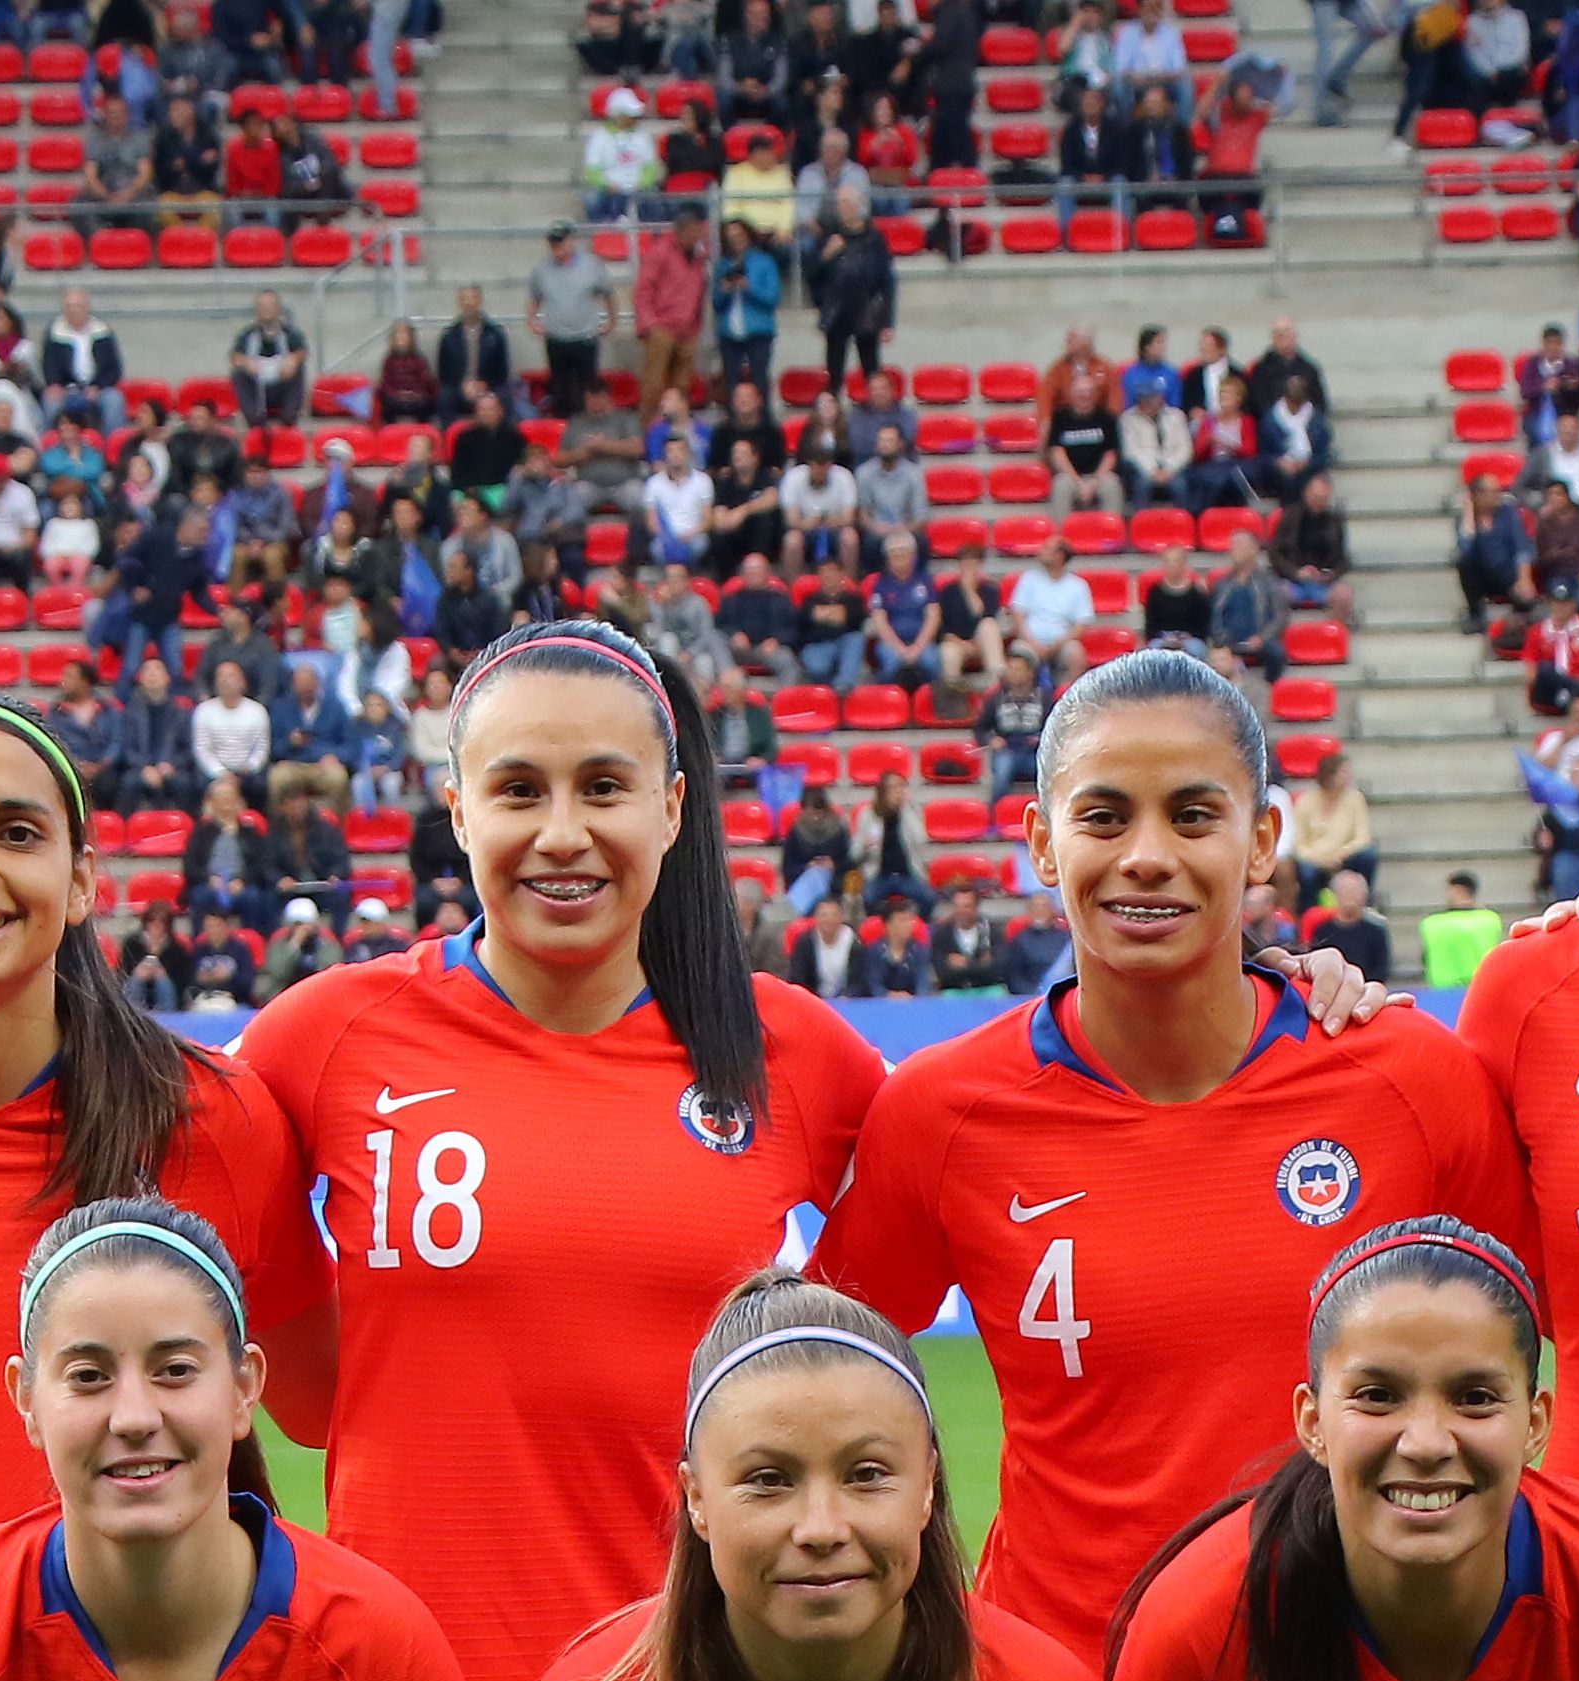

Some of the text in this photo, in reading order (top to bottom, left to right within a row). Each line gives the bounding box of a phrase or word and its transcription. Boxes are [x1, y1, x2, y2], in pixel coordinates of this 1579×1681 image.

[367, 1129, 486, 1268] 18
[1276, 1140, 1359, 1188] FEDERACION DE FUTBOL
[1420, 1233, 1454, 1244] NIKE
[1019, 1239, 1090, 1376] 4
